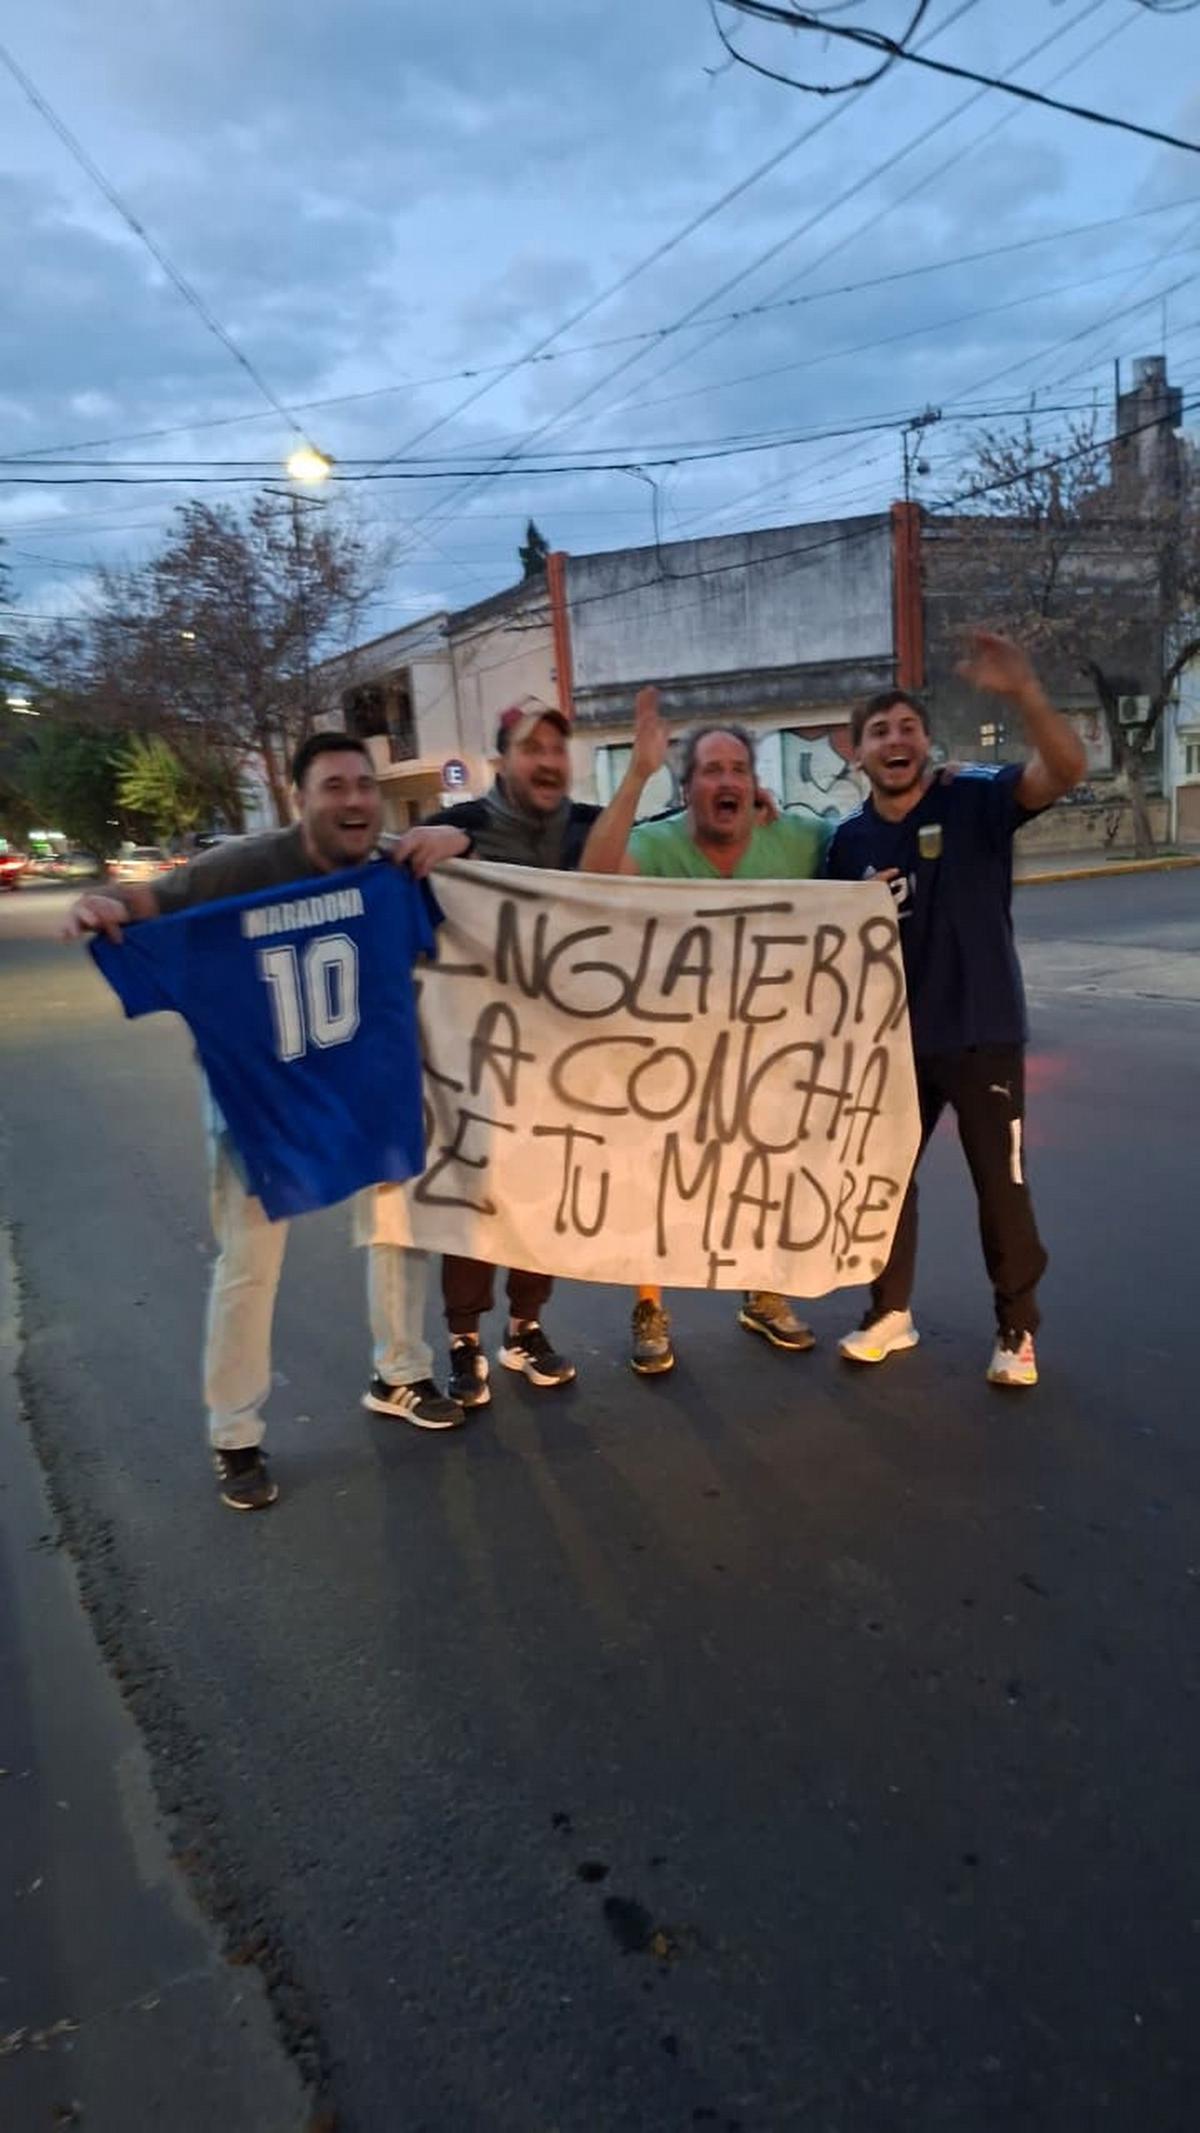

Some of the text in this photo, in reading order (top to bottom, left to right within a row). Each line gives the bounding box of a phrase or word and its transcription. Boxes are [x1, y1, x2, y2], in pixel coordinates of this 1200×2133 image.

[448, 765, 465, 784] E
[241, 887, 365, 940] MARADONA
[415, 866, 907, 1043] NGLATERR
[258, 932, 361, 1063] 10
[549, 1024, 890, 1165] CONCHA
[413, 1098, 900, 1258] E TU MADRE
